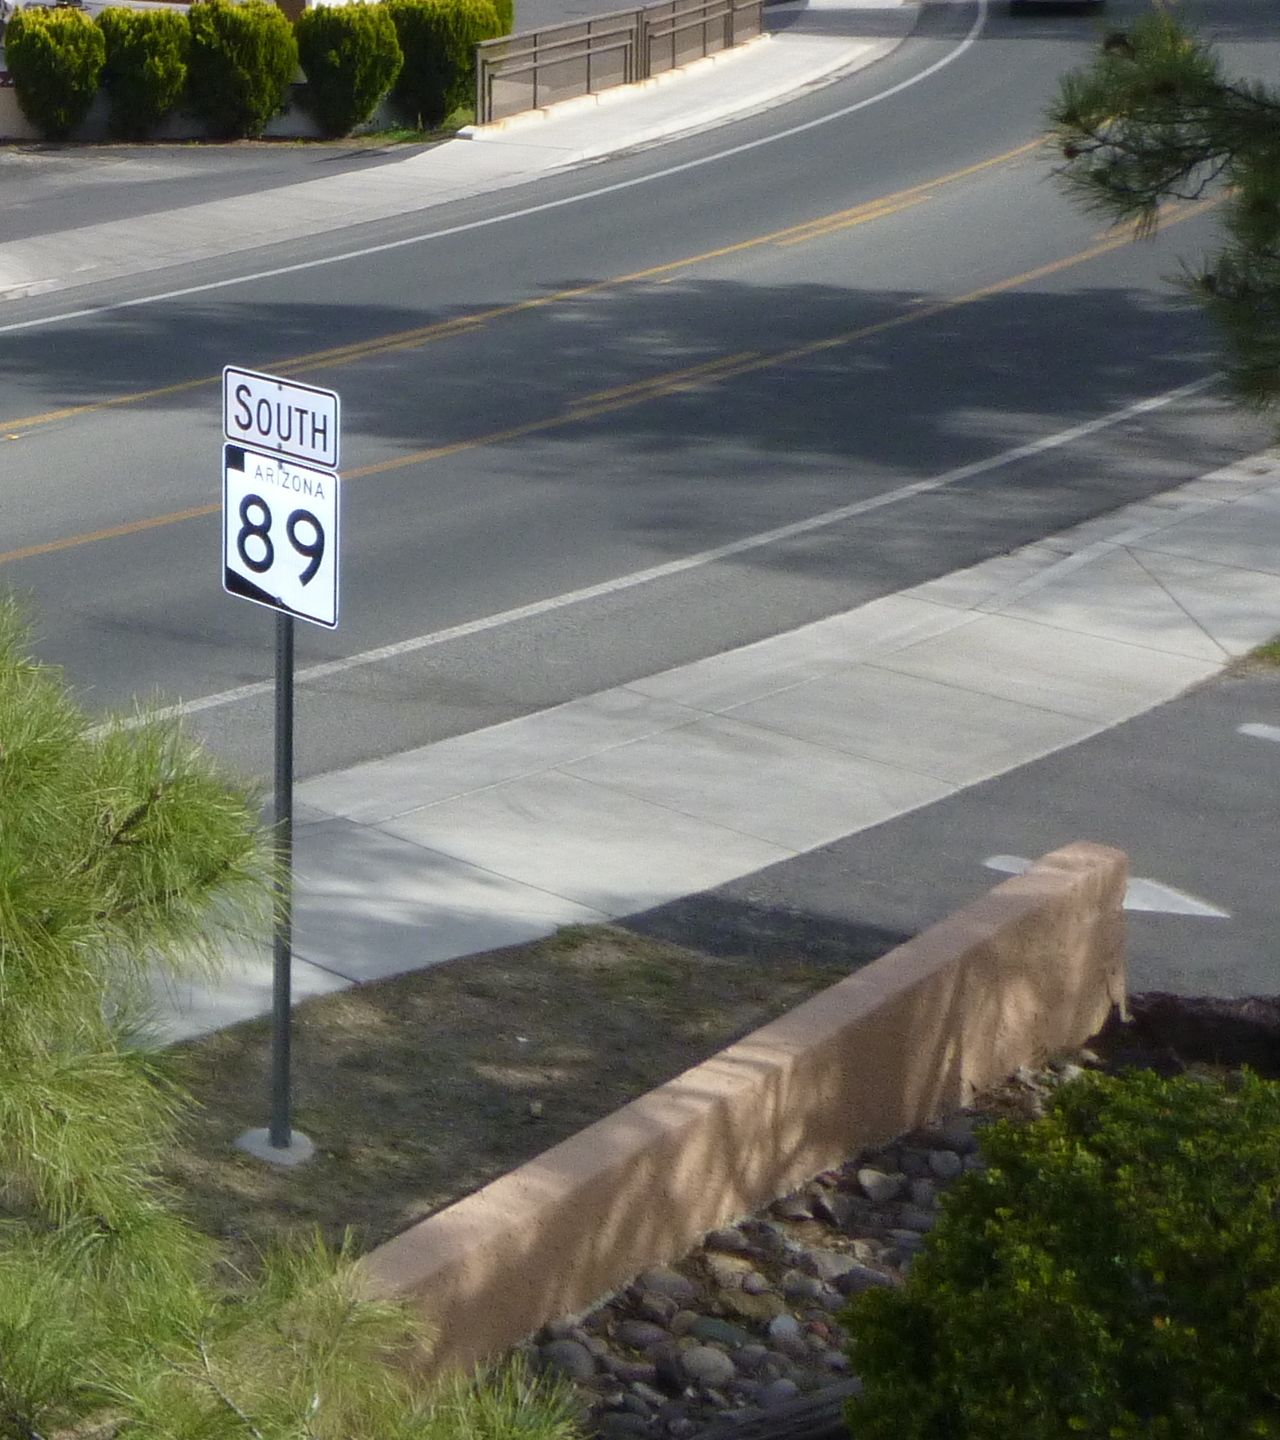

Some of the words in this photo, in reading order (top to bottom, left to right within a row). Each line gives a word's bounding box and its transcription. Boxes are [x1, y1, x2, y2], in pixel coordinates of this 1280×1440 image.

[234, 384, 328, 452] SOUTH
[254, 464, 326, 500] ARIZONA
[236, 493, 326, 588] 89
